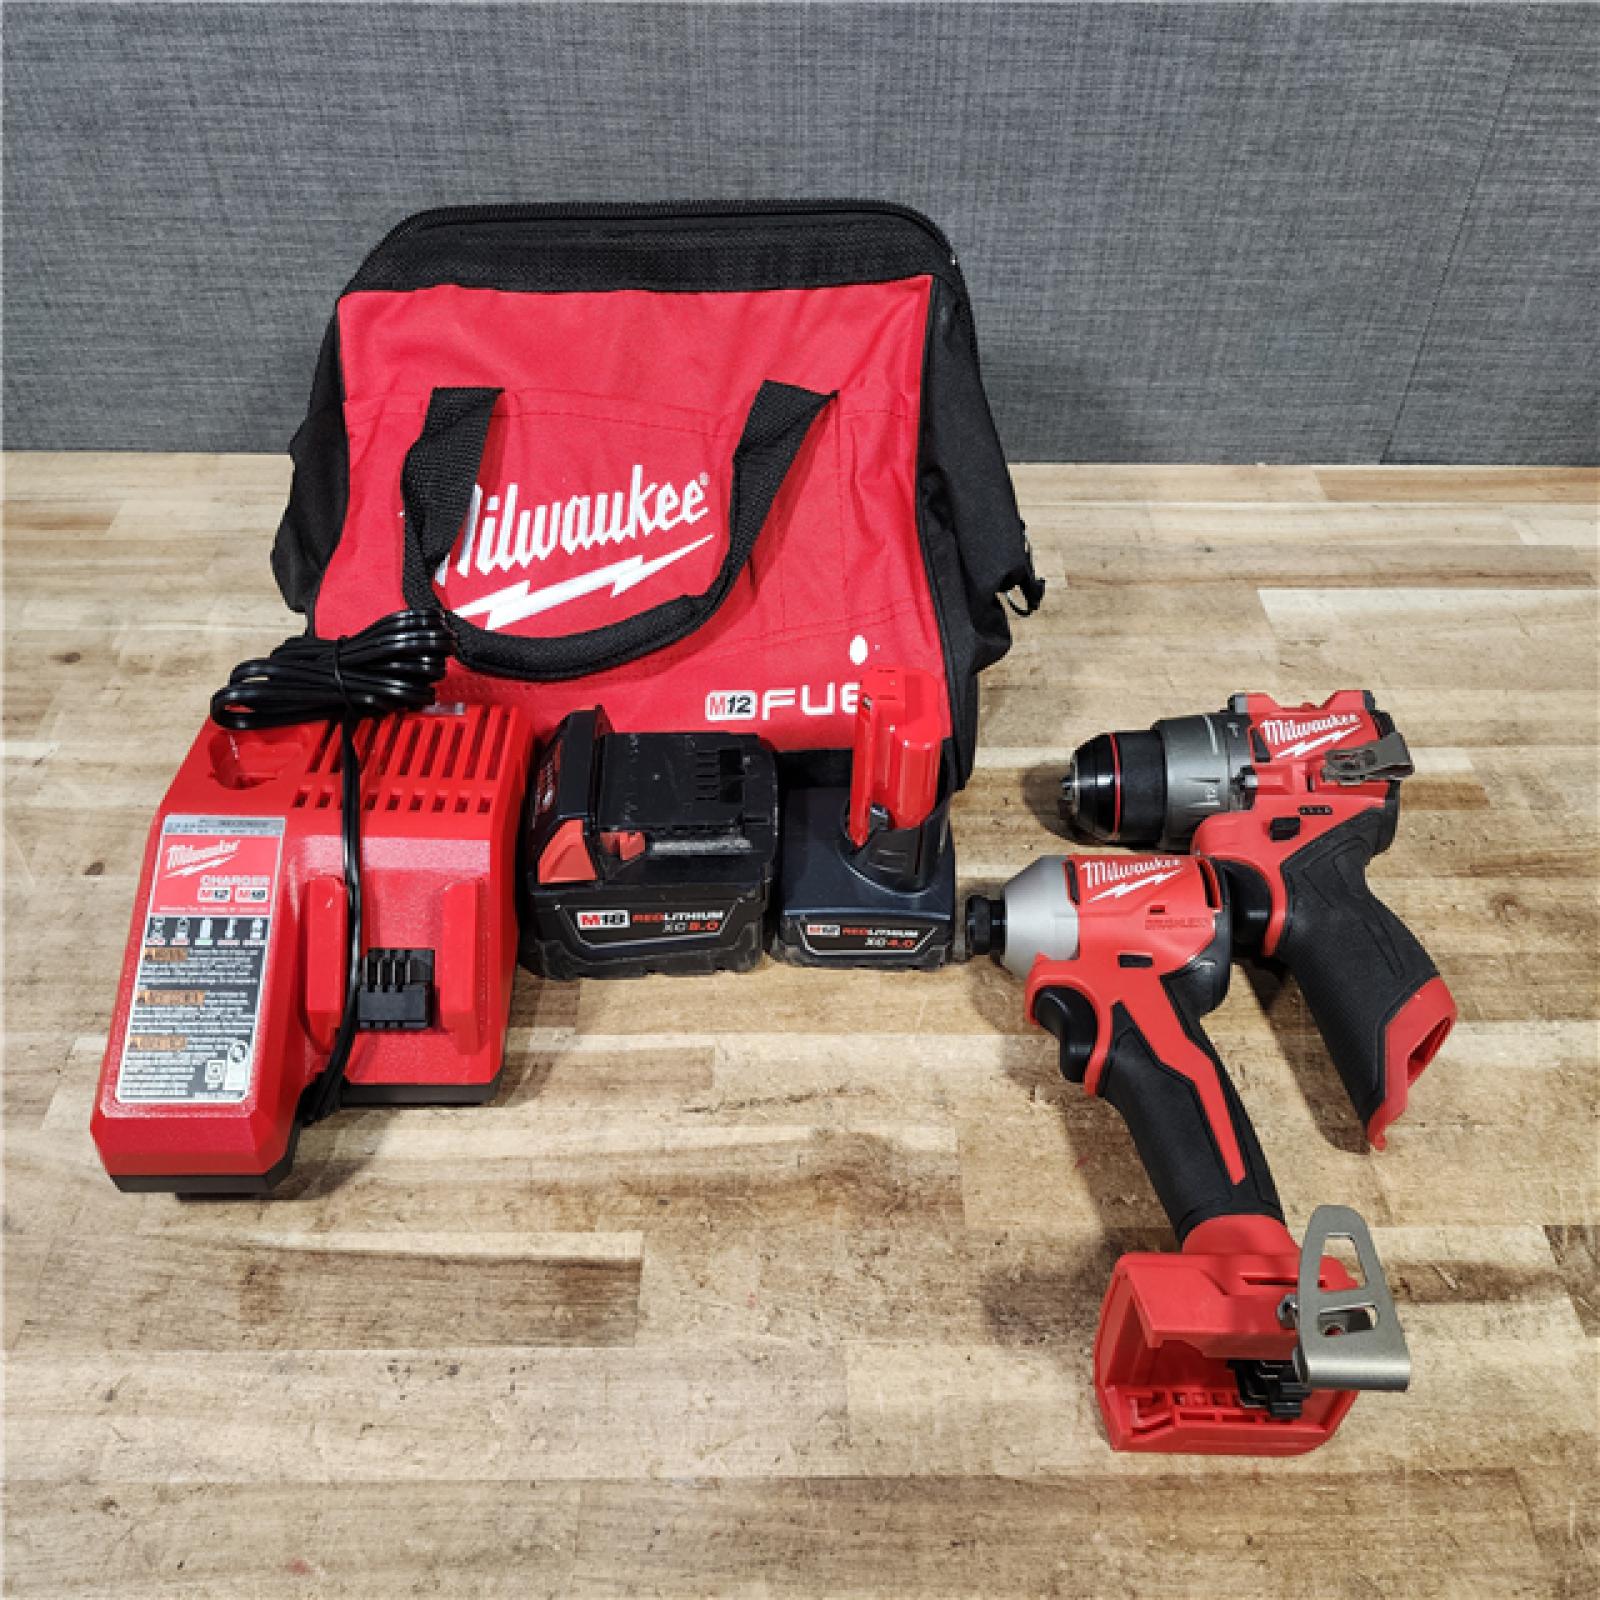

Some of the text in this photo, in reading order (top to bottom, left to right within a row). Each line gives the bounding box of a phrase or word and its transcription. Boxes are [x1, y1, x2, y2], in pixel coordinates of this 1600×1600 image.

[708, 682, 860, 720] M12 FUE
[1260, 714, 1359, 746] Milwaukee
[1080, 857, 1181, 888] Milwaukee
